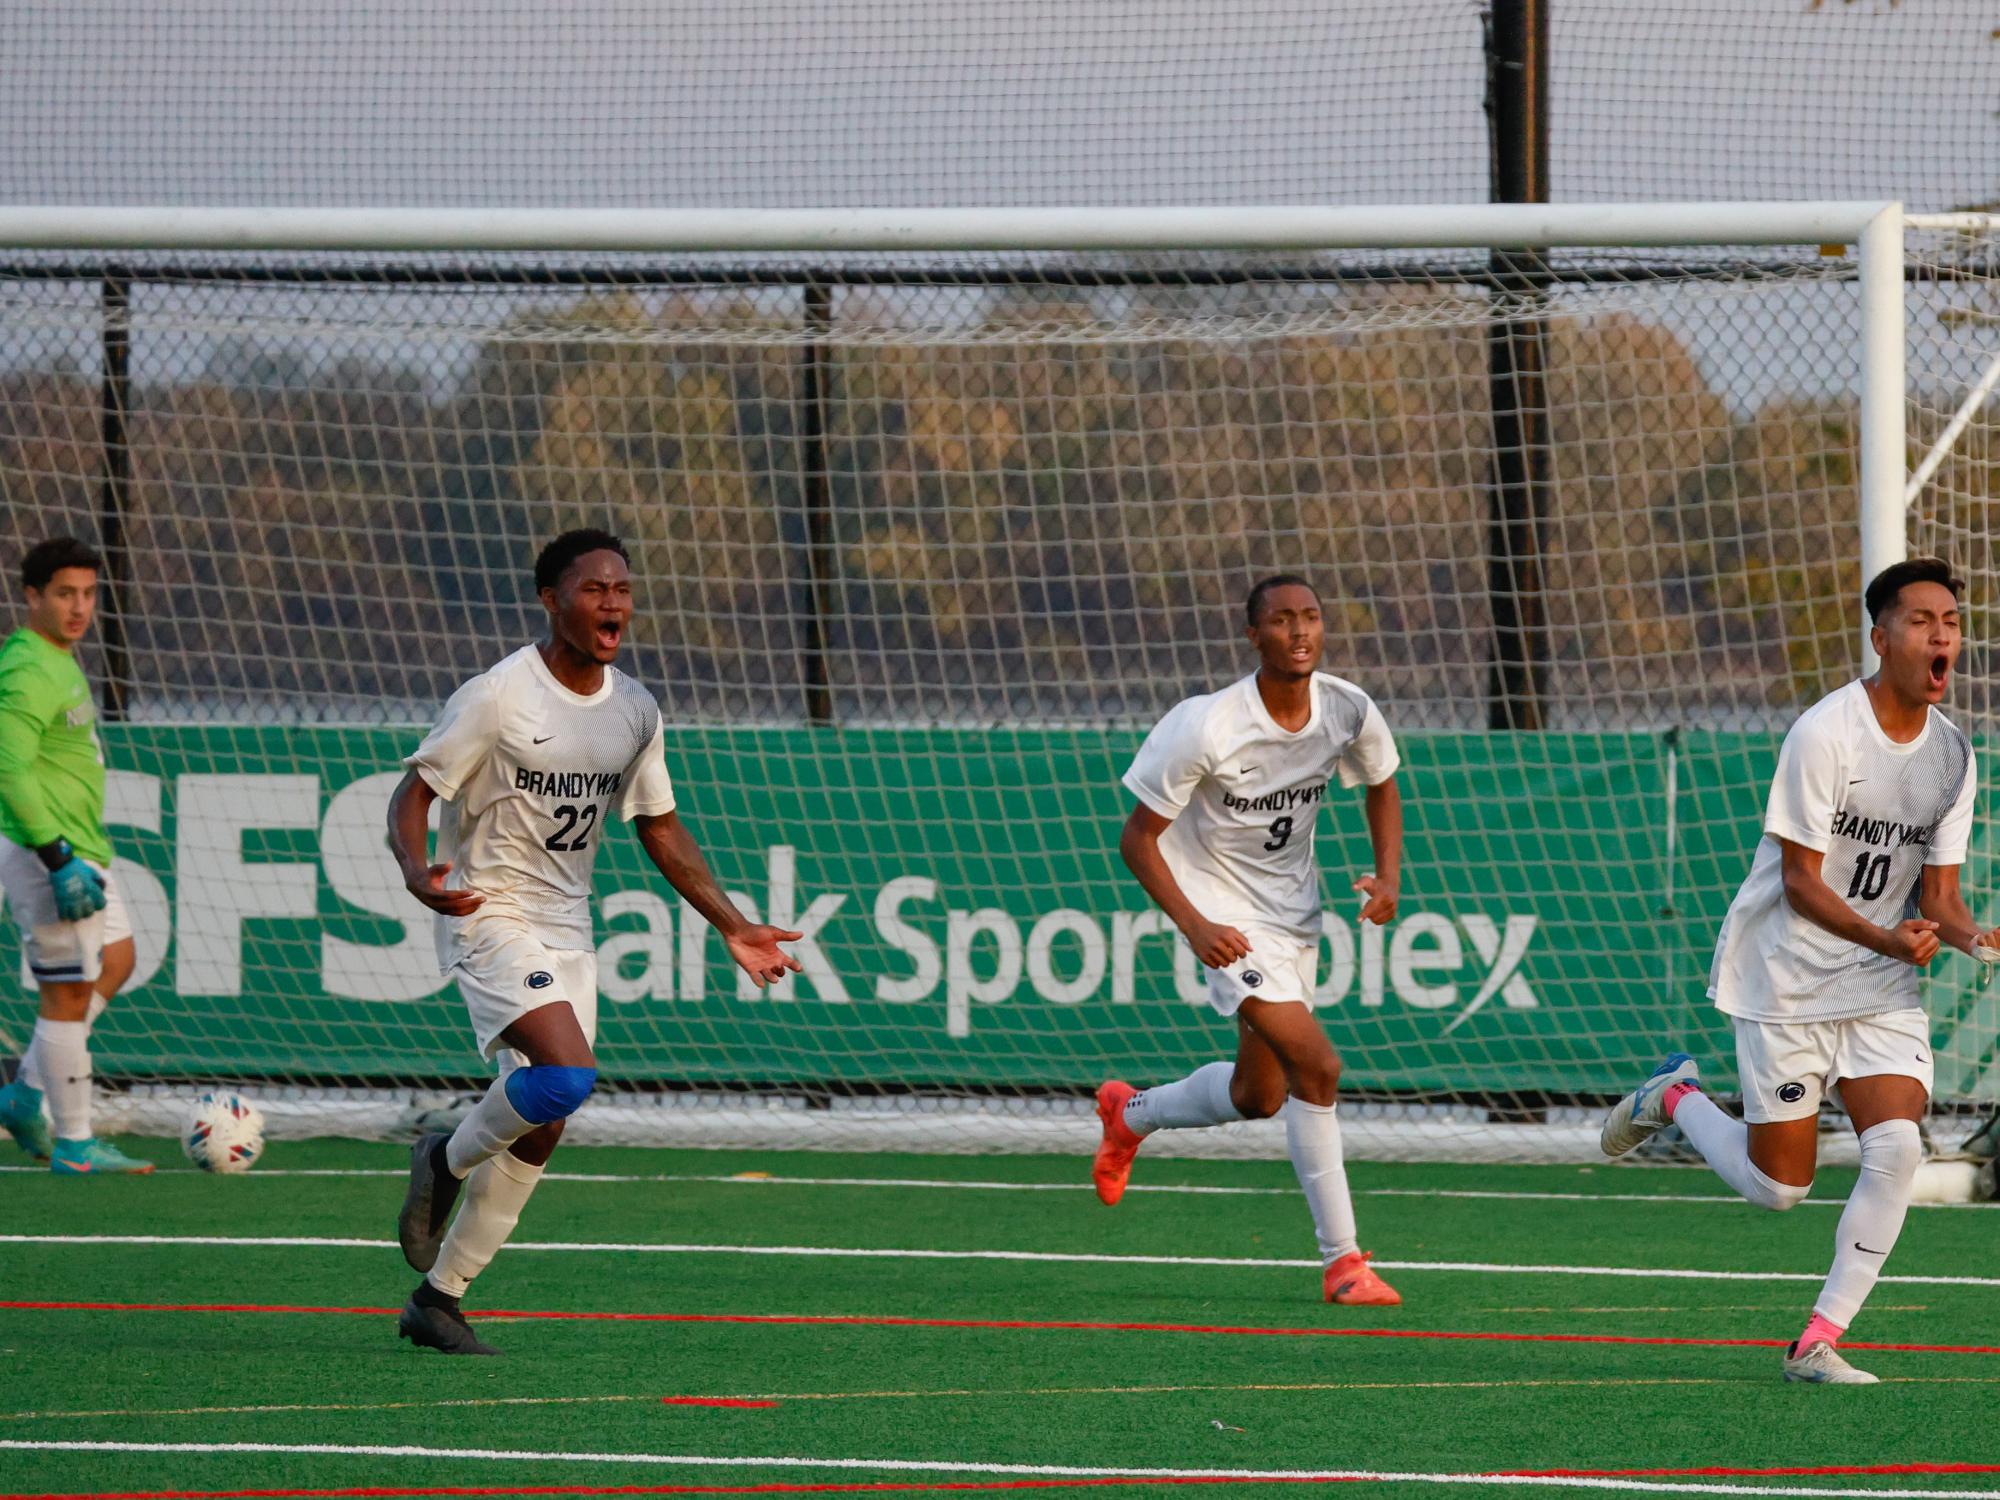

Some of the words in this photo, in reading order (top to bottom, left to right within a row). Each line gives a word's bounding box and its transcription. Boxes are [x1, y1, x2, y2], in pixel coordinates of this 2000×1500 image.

[545, 804, 598, 852] 22
[1263, 816, 1293, 851] 9
[1847, 851, 1892, 901] 10
[597, 845, 850, 1003] ank
